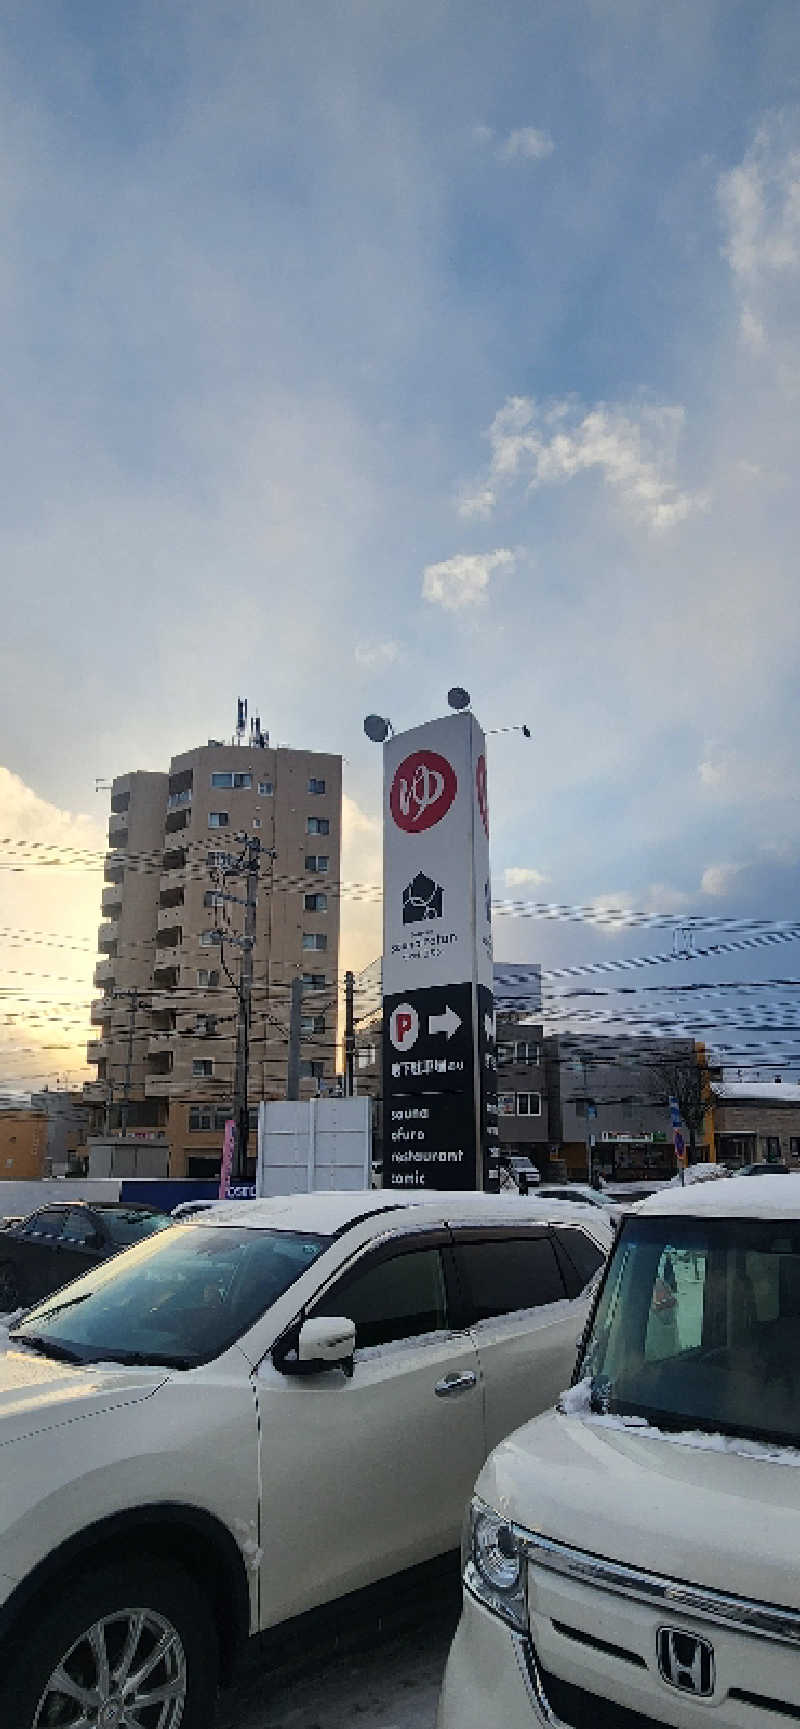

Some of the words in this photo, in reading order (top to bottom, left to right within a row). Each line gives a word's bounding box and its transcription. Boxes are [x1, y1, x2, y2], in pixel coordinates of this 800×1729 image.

[399, 763, 445, 822] ゆ
[395, 1013, 412, 1042] P
[391, 1108, 430, 1120] sauna
[391, 1126, 425, 1142] ofuro
[391, 1149, 464, 1163] restaurant
[391, 1169, 425, 1185] comic
